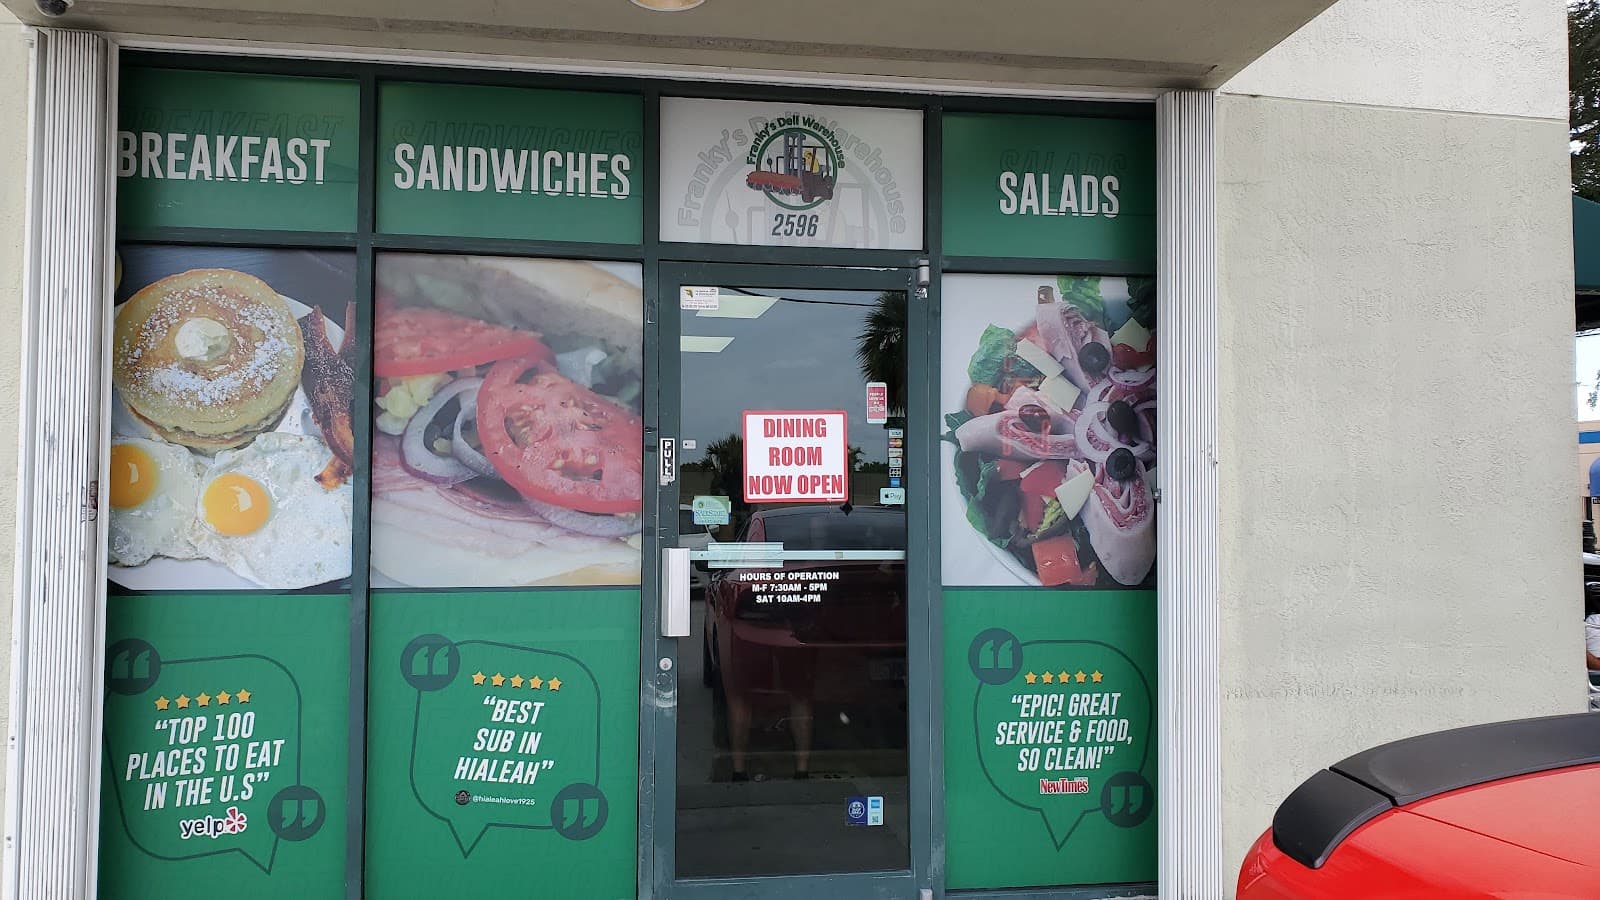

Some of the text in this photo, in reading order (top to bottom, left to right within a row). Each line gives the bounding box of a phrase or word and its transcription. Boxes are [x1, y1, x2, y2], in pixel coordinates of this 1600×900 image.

[747, 122, 777, 165] Franky's
[802, 116, 845, 168] Warehouse
[117, 131, 330, 184] BREAKFAST
[394, 143, 631, 200] SANDWICHES
[1000, 171, 1119, 218] SALADS
[772, 213, 818, 237] 2596
[763, 418, 827, 438] DINING
[768, 446, 822, 467] ROOM
[748, 475, 843, 495] NOW OPEN
[740, 572, 839, 581] HOURS OF OPERATION
[752, 583, 768, 592] M-F
[770, 583, 802, 592] 7:30AM
[809, 583, 828, 591] 5PM
[756, 594, 821, 603] SAT 10AM-4PM
[1068, 692, 1121, 716] GREAT
[213, 712, 255, 741] 100
[995, 719, 1132, 745] SERVICE & FOOD,
[473, 728, 542, 755] SUB IN
[126, 739, 285, 781] PLACES TO EAT
[1017, 748, 1041, 772] SO
[144, 781, 168, 811] IN
[175, 777, 214, 808] THE
[181, 816, 224, 838] yelp
